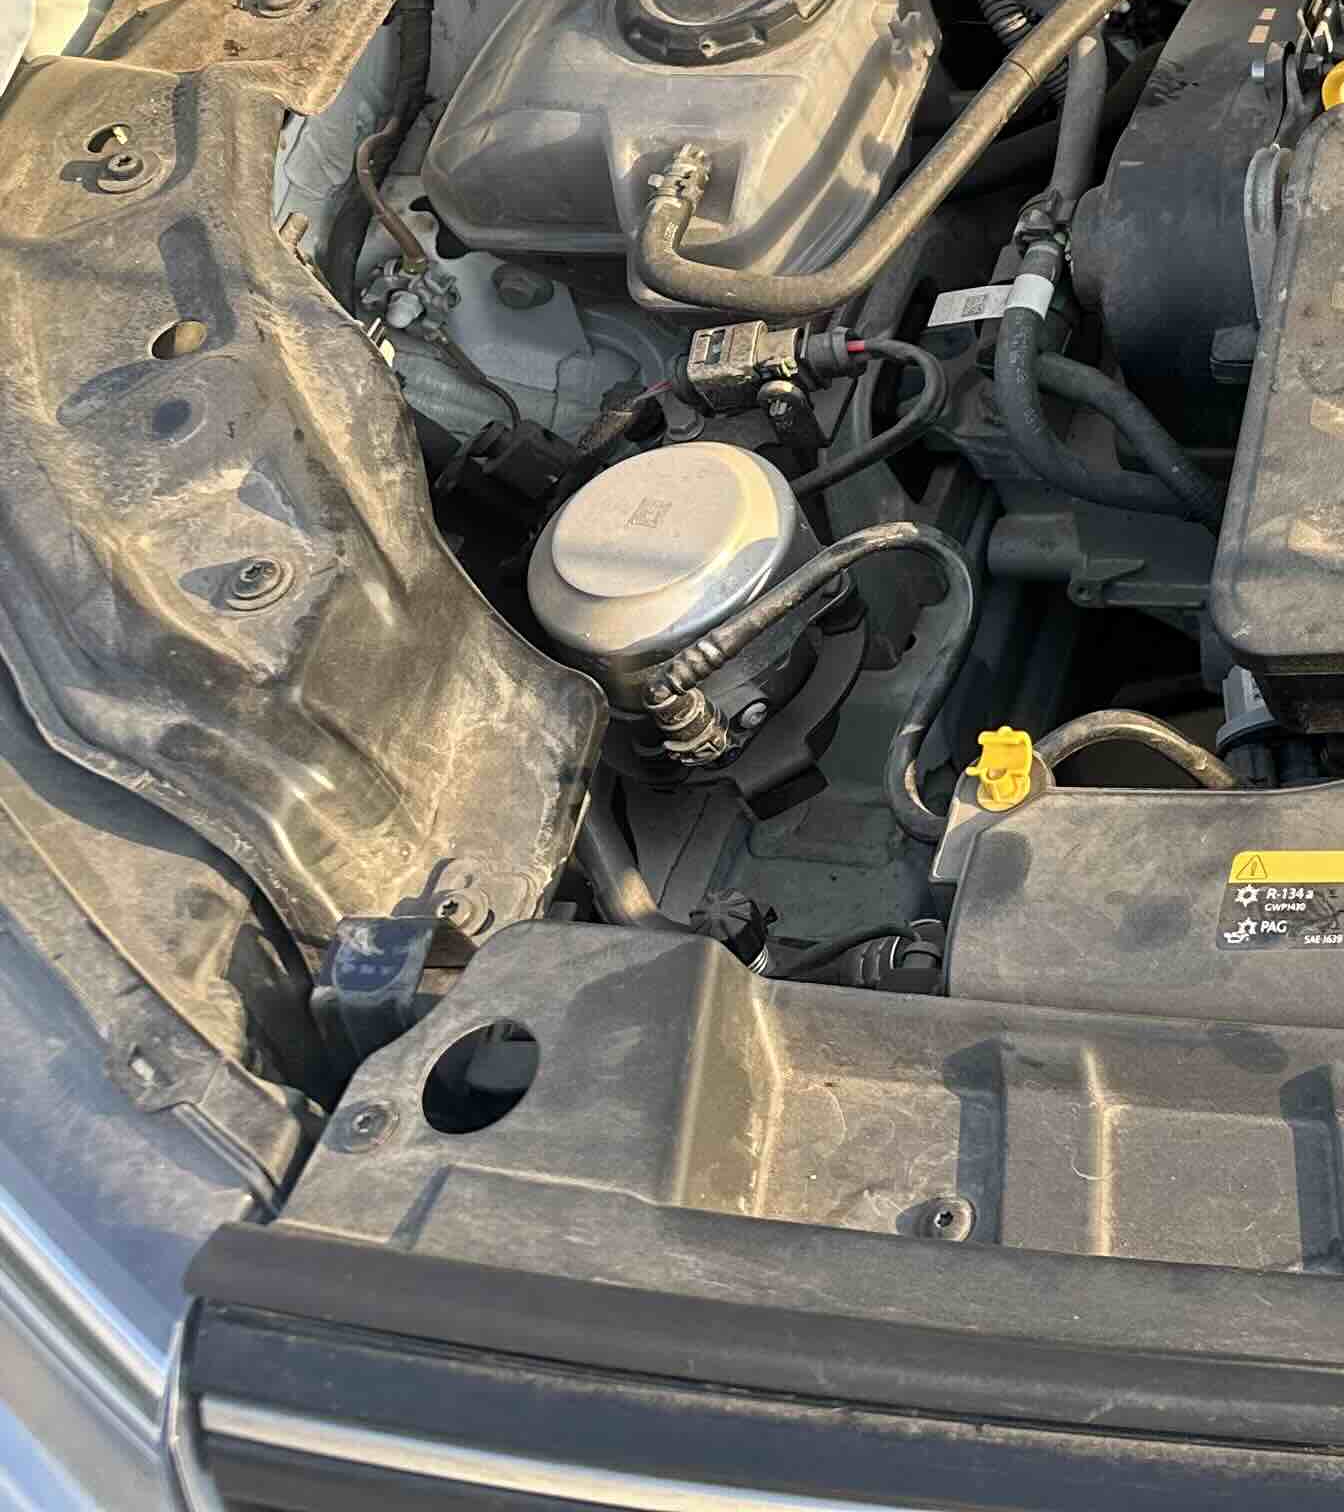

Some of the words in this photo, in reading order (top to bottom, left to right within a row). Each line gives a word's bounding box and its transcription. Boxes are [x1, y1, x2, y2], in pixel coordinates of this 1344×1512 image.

[1260, 920, 1288, 933] PAG
[1304, 934, 1322, 944] SAE
[1323, 934, 1343, 944] J639
